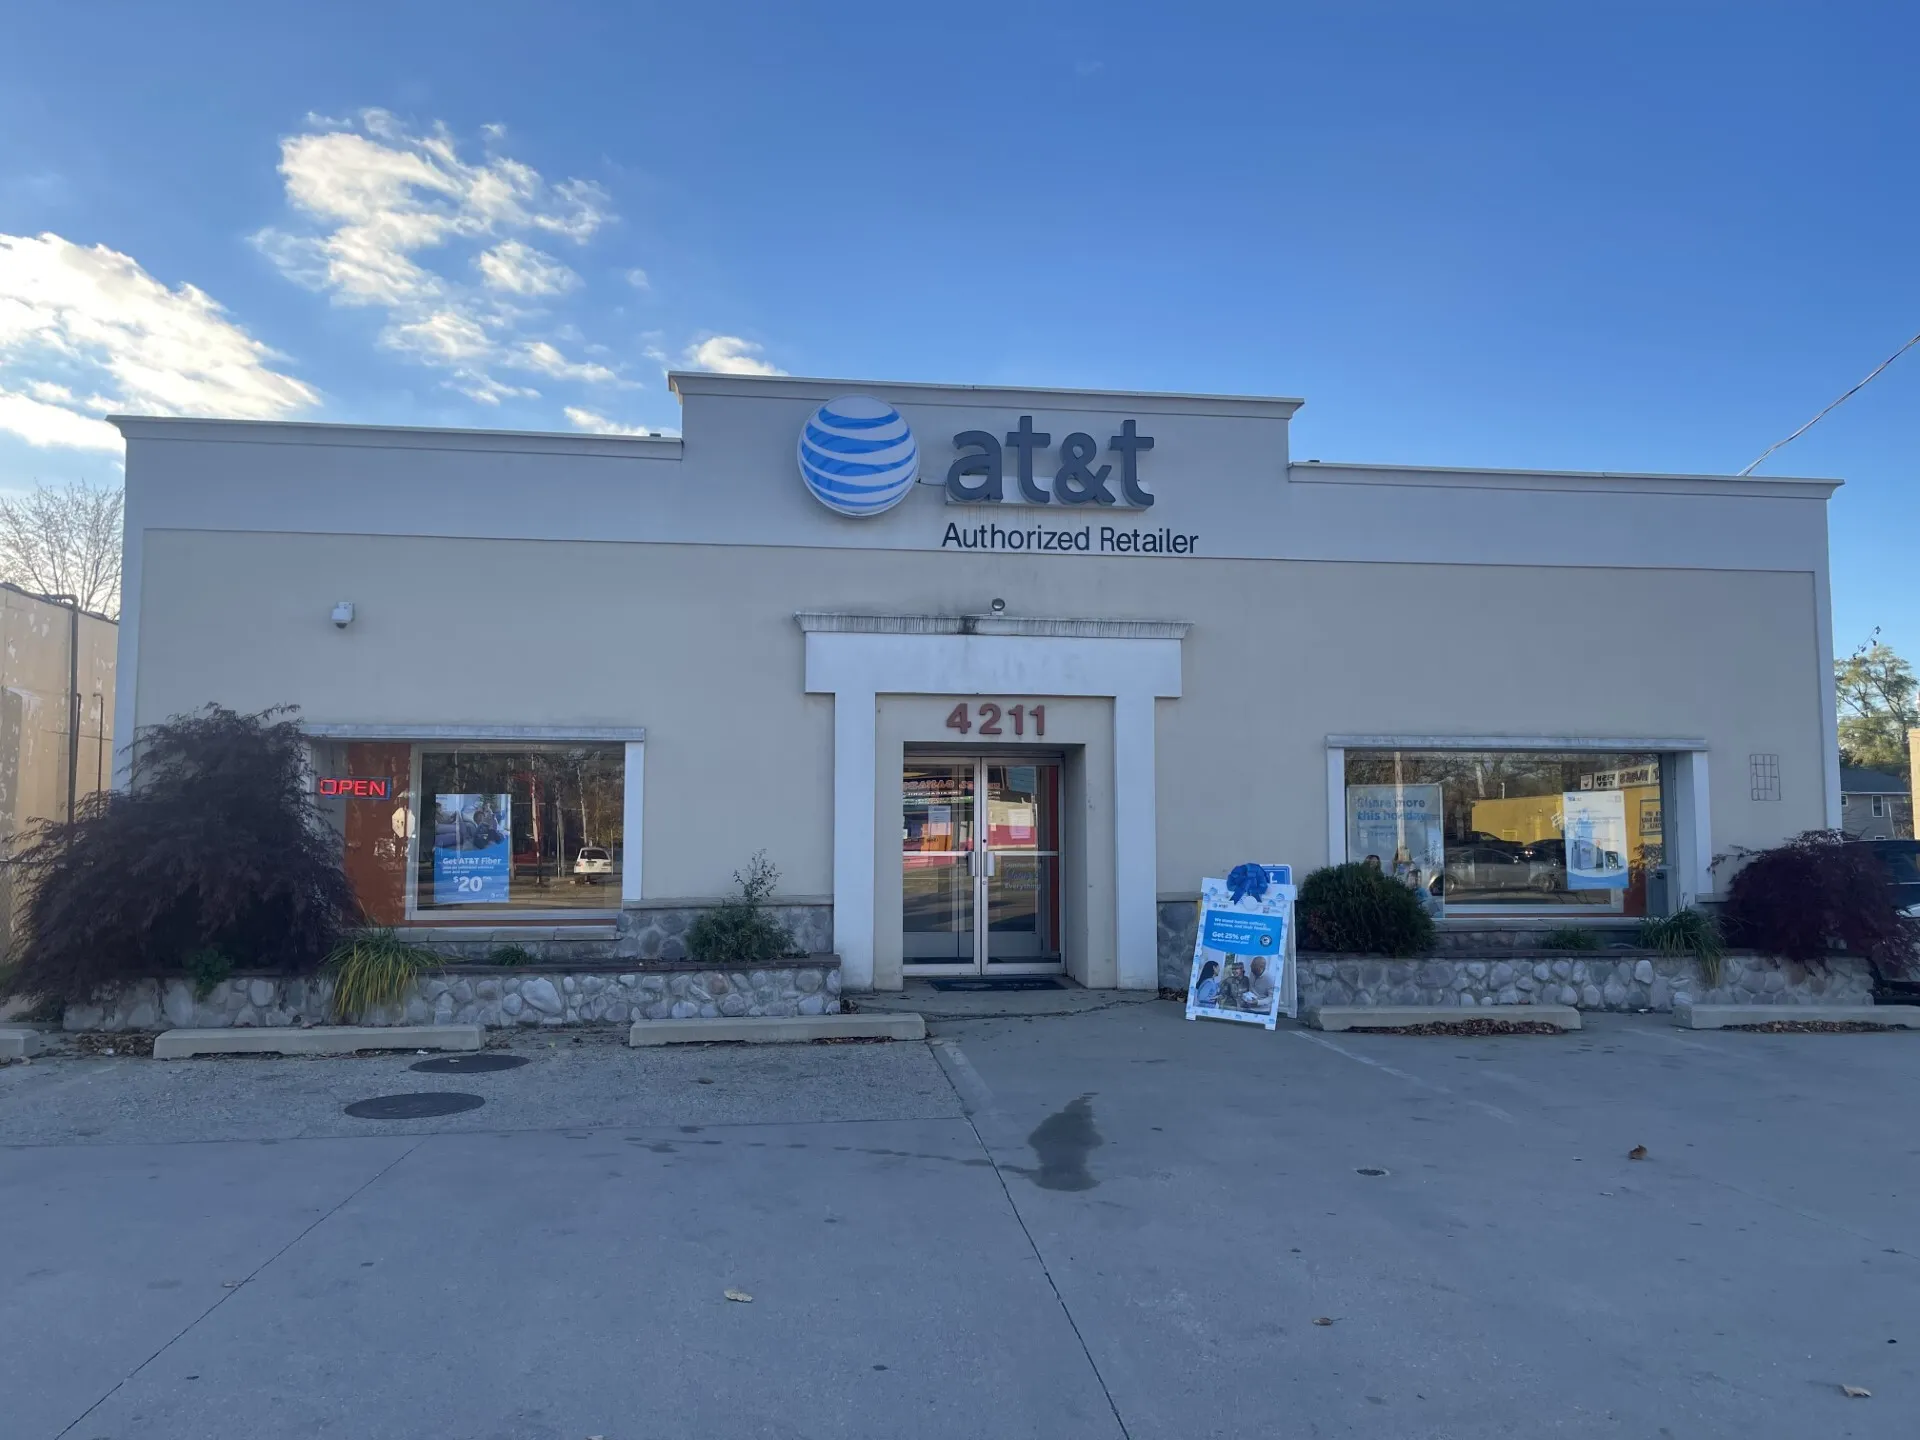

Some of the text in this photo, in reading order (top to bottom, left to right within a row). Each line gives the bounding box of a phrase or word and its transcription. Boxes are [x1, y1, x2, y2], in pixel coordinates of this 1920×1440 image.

[945, 415, 1155, 507] at&t
[942, 523, 1199, 554] Authorized Retailer
[946, 702, 1045, 736] 4211
[320, 779, 385, 796] OPEN
[1357, 810, 1426, 823] this hoday
[458, 857, 479, 865] AT&T
[480, 857, 502, 865] Fiber
[1225, 932, 1239, 940] 25%
